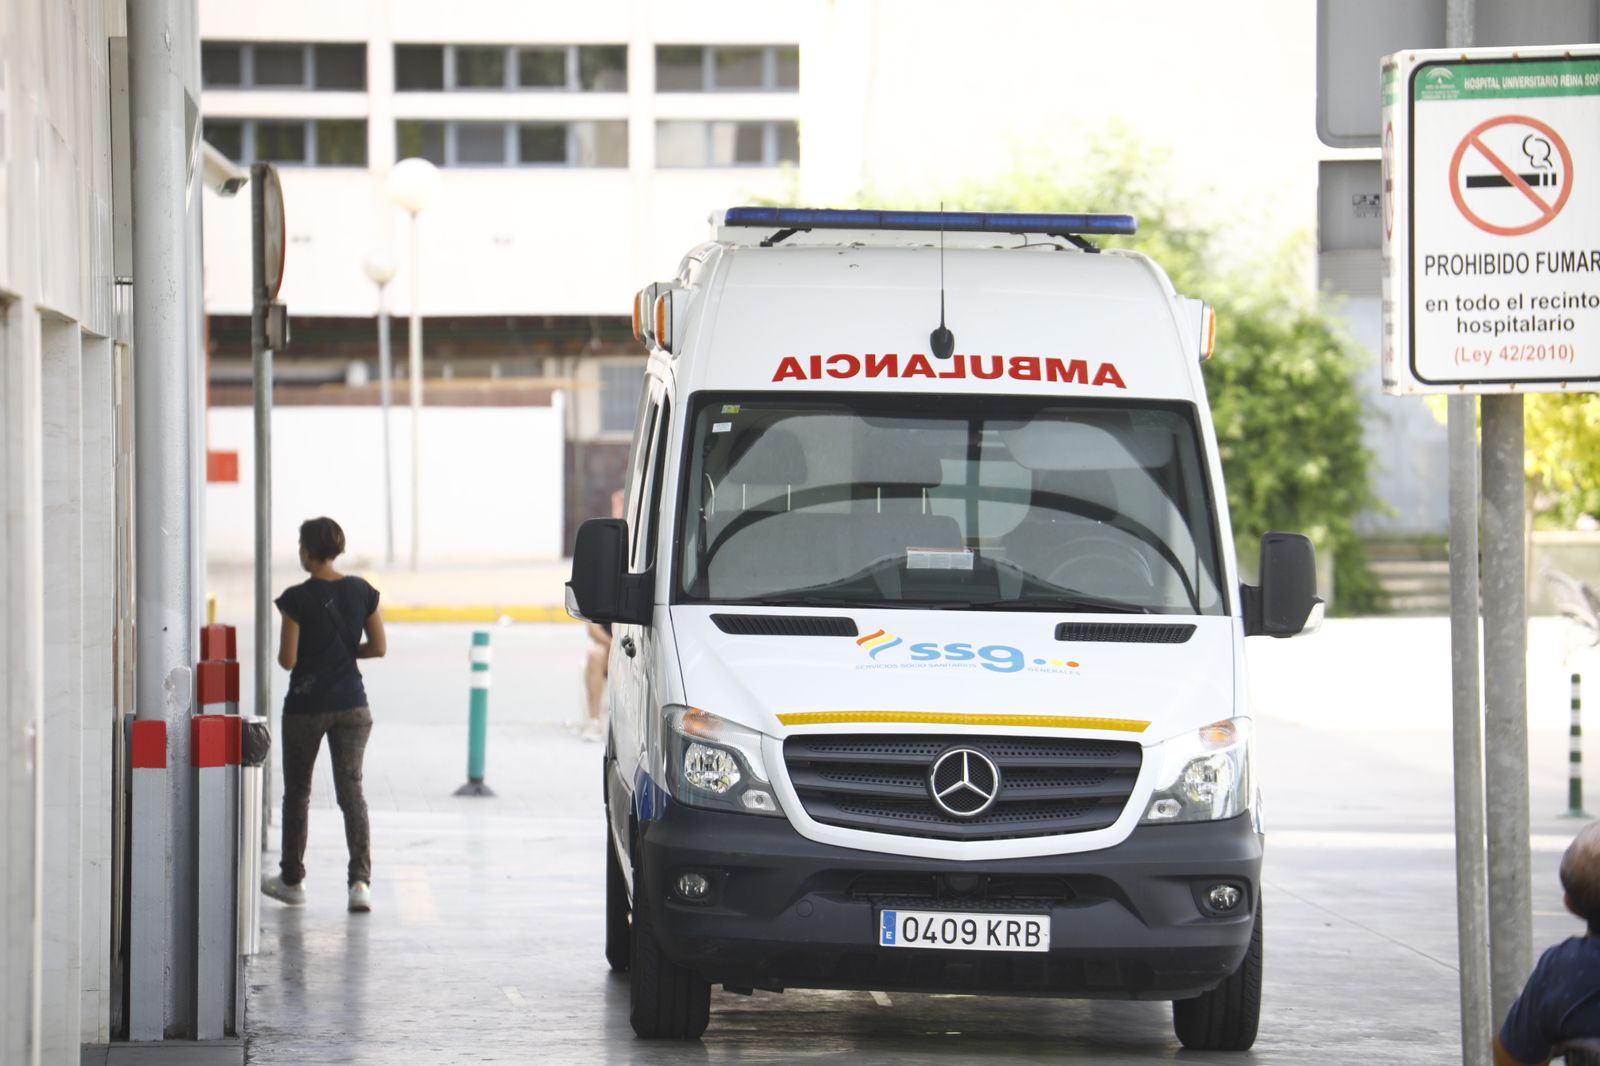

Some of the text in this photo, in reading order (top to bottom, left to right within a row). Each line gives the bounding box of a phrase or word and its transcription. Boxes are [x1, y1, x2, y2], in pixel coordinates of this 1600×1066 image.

[1464, 77, 1500, 90] HOSPITAL
[1502, 75, 1558, 89] UNIVERSITARIO
[1560, 74, 1583, 87] REINA
[1425, 250, 1600, 276] PROHIBIDO FUMAR
[1425, 291, 1600, 312] en todo el recinto
[1457, 315, 1576, 337] hospitalario
[1454, 344, 1575, 365] (Ley 42/2010)
[855, 663, 898, 671] SERVICIOS
[909, 642, 1025, 673] ssg
[885, 931, 893, 940] E
[902, 916, 1041, 947] 0409 KRB
